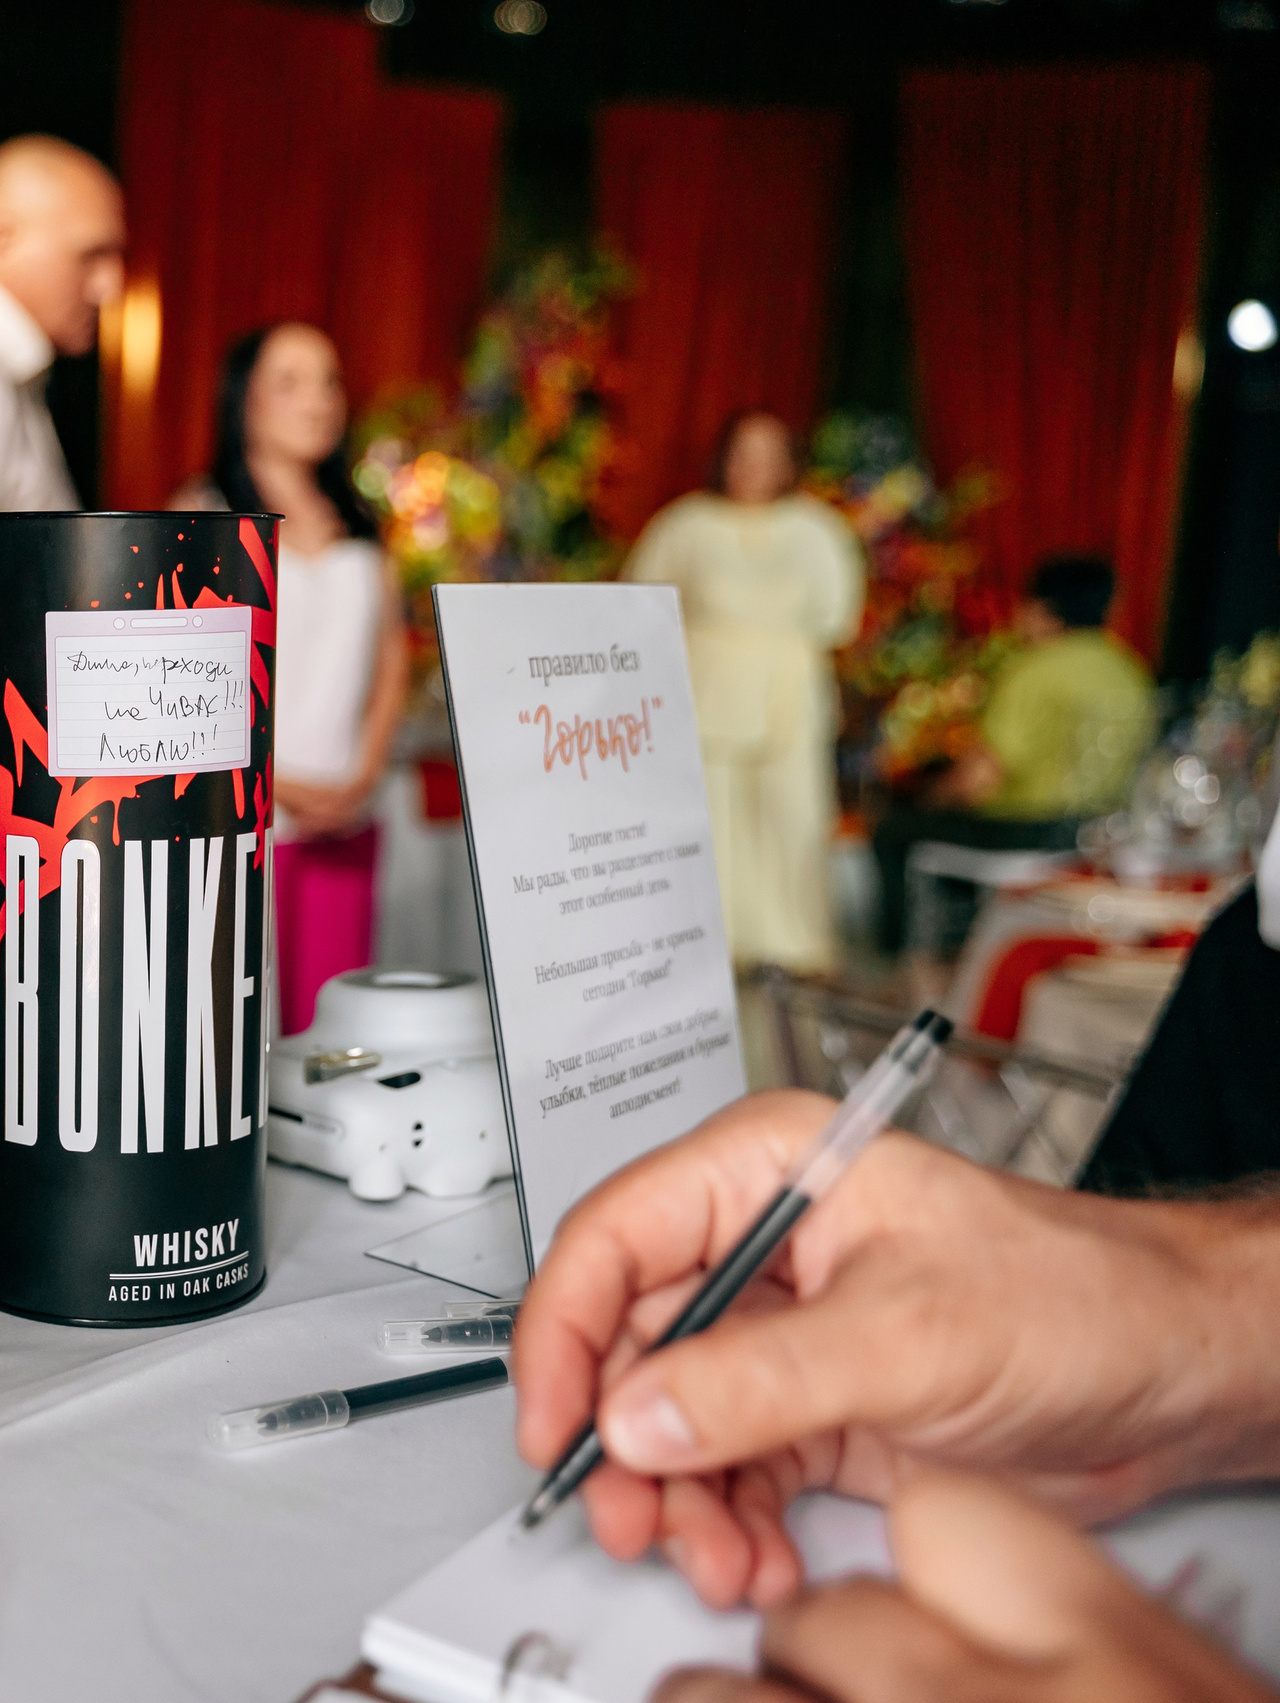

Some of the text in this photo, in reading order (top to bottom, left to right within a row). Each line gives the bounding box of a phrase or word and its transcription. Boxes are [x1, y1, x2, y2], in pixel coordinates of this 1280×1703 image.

[528, 643, 642, 687] правило без
[568, 832, 613, 855] Дорогие
[513, 874, 534, 894] Мы
[570, 864, 590, 881] что
[558, 896, 585, 916] этот
[534, 954, 599, 984] Небольшая
[4, 828, 273, 1155] BONKE
[545, 1054, 582, 1082] Лучше
[539, 1084, 587, 1119] улыбки,
[133, 1218, 240, 1267] WHISKY
[108, 1262, 249, 1302] AGED IN OAK CASKS
